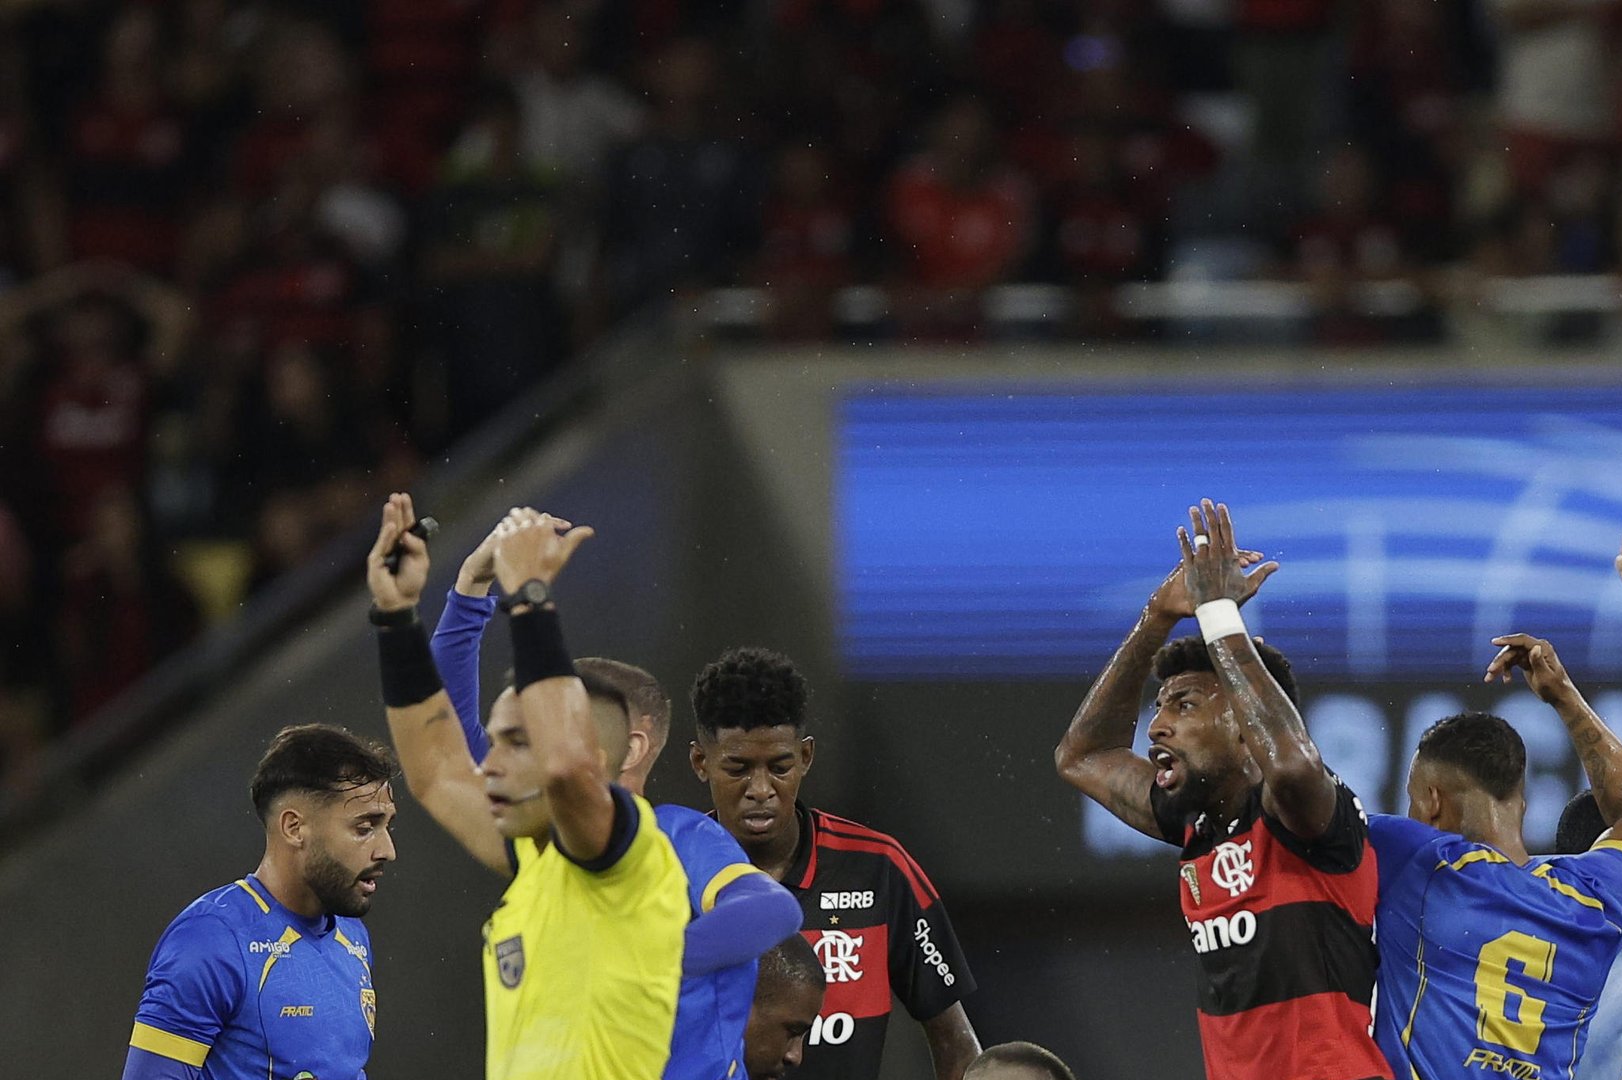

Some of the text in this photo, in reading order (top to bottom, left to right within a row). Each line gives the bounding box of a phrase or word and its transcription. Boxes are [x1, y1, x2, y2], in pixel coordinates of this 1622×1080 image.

[837, 890, 875, 910] BRB
[913, 917, 956, 987] Shopee
[279, 1005, 314, 1018] PRATIC
[1473, 929, 1558, 1056] 6
